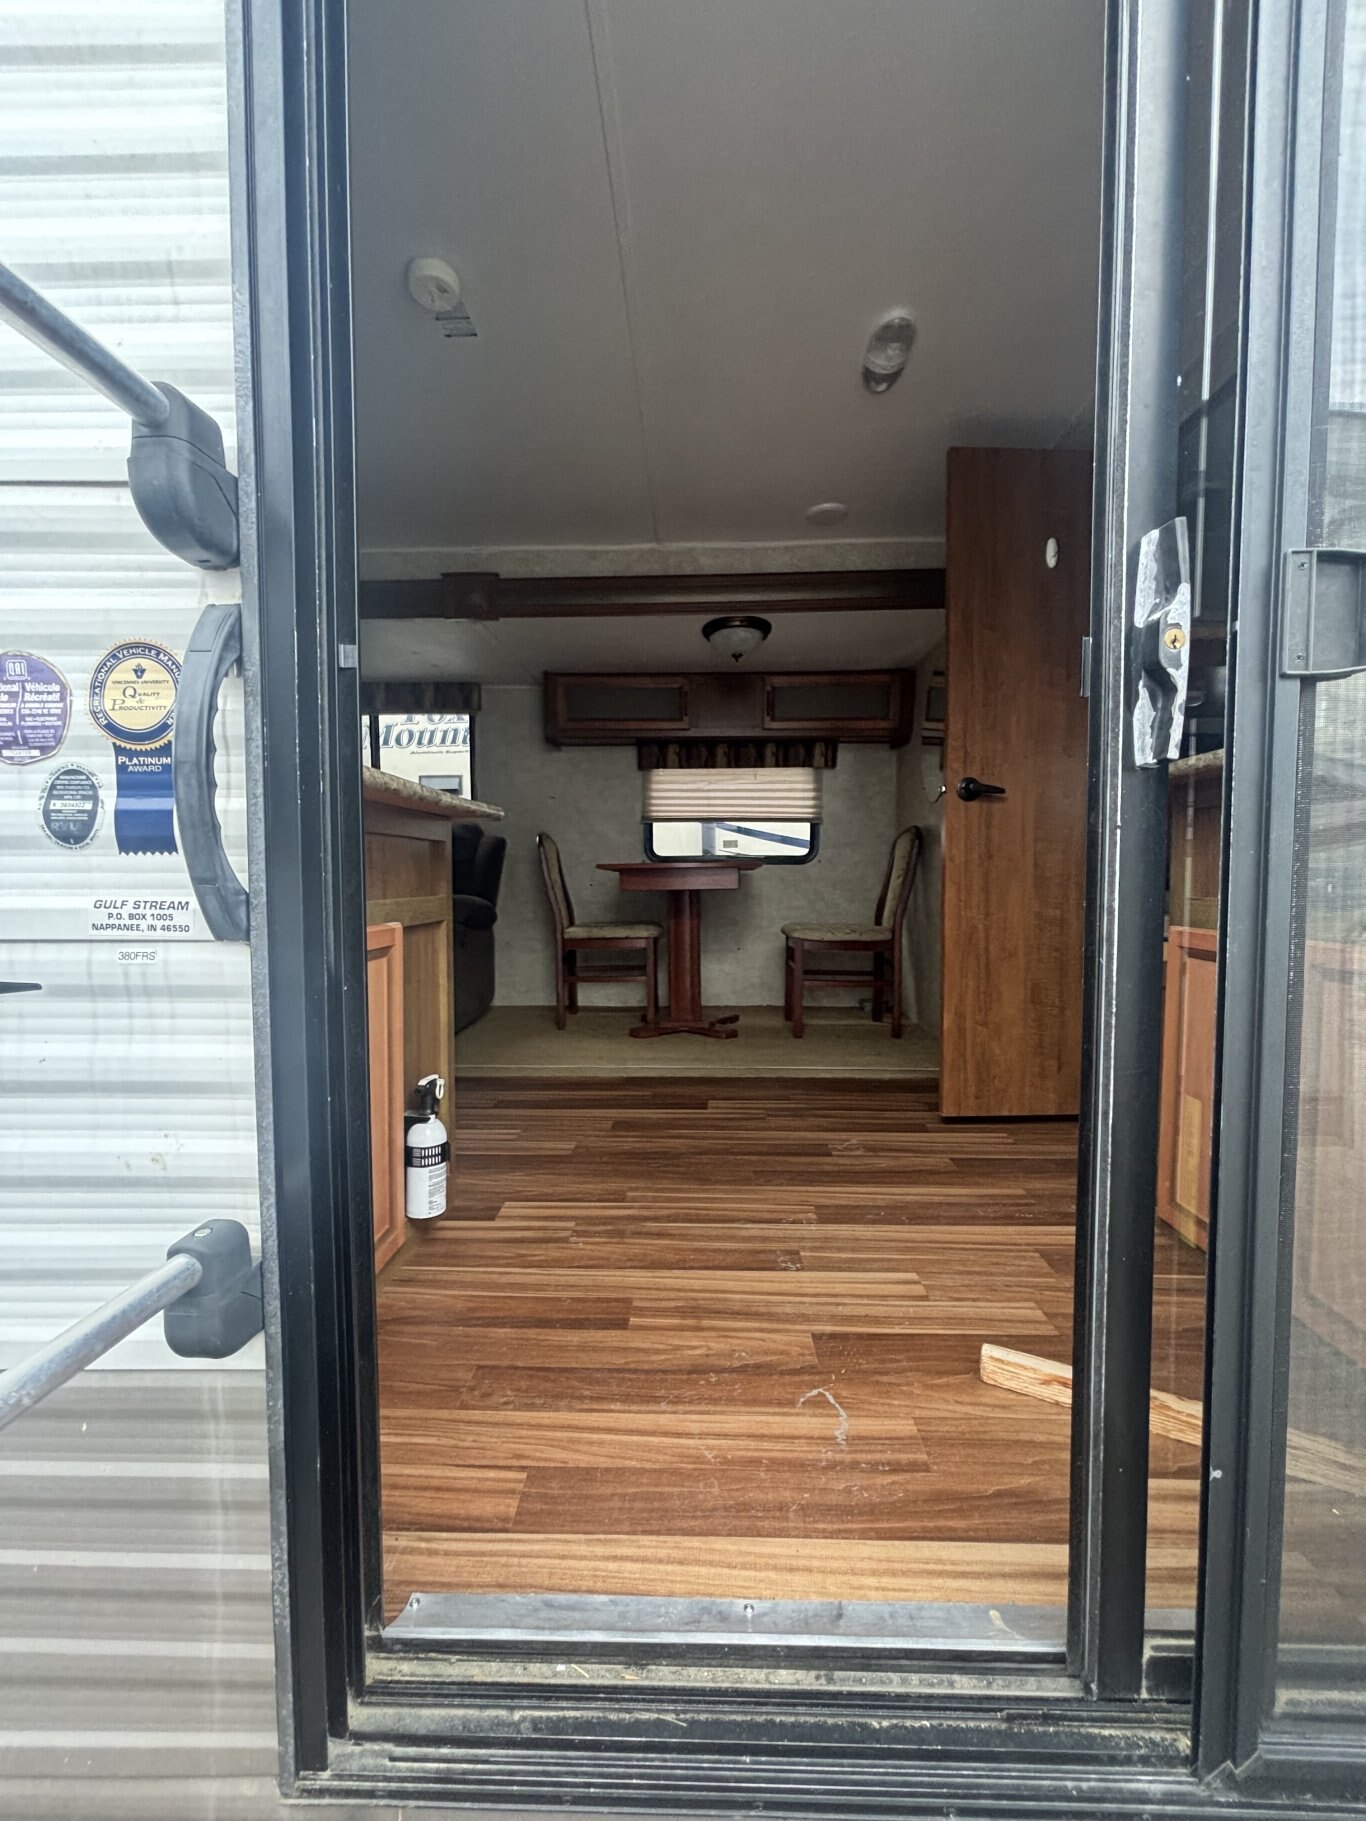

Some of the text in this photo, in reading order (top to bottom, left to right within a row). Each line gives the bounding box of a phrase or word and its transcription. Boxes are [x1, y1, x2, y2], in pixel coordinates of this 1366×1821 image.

[93, 657, 118, 725] RECREATIONAL
[115, 647, 158, 659] VEHICLE
[122, 685, 160, 699] QUALITY
[108, 698, 168, 711] PRODUCTIVITY
[117, 756, 171, 765] PLATINUM
[93, 899, 190, 911] GULF STREAM
[107, 912, 174, 921] P.O. BOX 1005
[91, 923, 190, 933] NAPPANEE, IN 46550
[118, 951, 156, 961] 380FRS
